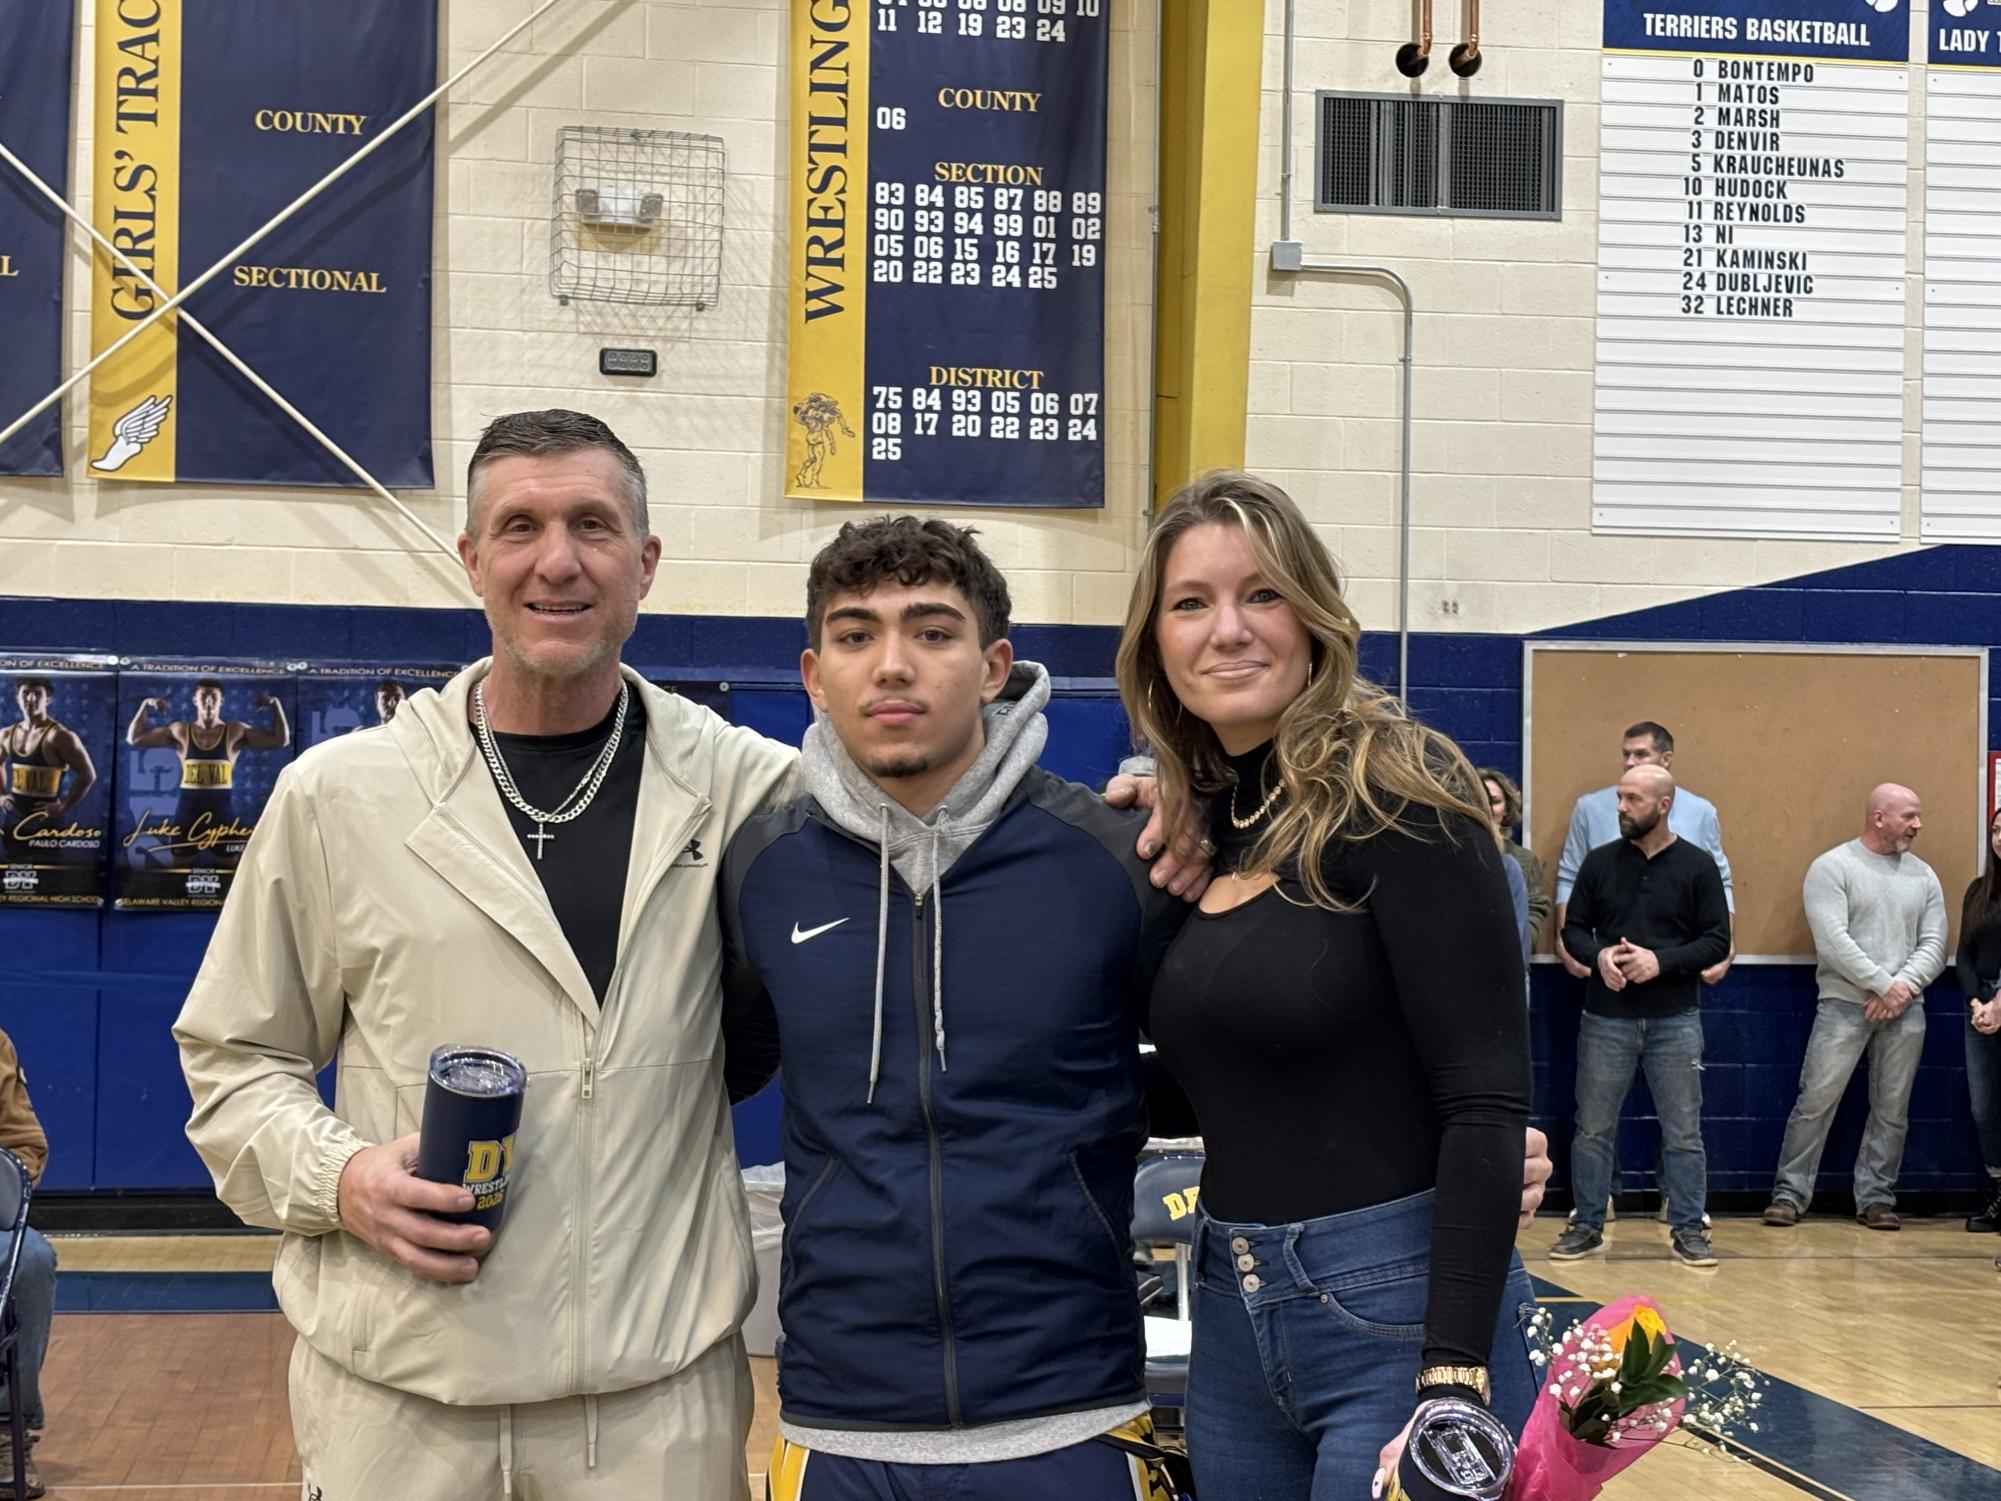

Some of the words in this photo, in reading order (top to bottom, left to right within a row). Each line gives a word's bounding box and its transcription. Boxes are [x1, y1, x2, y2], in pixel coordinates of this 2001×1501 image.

[1076, 0, 1099, 17] 10
[878, 9, 896, 31] 11
[918, 11, 942, 33] 12
[959, 13, 982, 36] 19
[997, 16, 1025, 38] 23
[1037, 19, 1065, 41] 24
[1644, 14, 1737, 39] TERRIERS
[1747, 18, 1870, 46] BASKETBALL
[1940, 29, 1989, 52] LADY
[1694, 59, 1703, 77] 0
[1719, 60, 1813, 82] BONTEMPO
[939, 88, 1040, 111] COUNTY
[1695, 83, 1703, 101] 1
[1719, 84, 1778, 104] MATOS
[256, 110, 366, 134] COUNTY
[877, 107, 905, 129] 06
[1693, 107, 1704, 126] 2
[1718, 107, 1779, 128] MARSH
[1692, 130, 1701, 148] 3
[1715, 131, 1779, 151] DENVIR
[805, 0, 851, 324] WRESTLING
[935, 162, 1043, 185] SECTION
[1692, 153, 1701, 172] 5
[1714, 154, 1843, 177] KRAUCHEUNAS
[876, 182, 904, 205] 83
[915, 184, 944, 207] 84
[955, 186, 983, 208] 85
[995, 188, 1023, 210] 87
[1034, 190, 1061, 212] 88
[1073, 192, 1100, 214] 89
[1684, 177, 1701, 195] 10
[1716, 178, 1786, 199] HUDOCK
[875, 208, 903, 230] 90
[915, 210, 943, 232] 93
[955, 212, 983, 234] 94
[994, 214, 1022, 236] 99
[1034, 216, 1055, 238] 01
[1072, 218, 1100, 239] 02
[1688, 201, 1701, 219] 11
[1714, 202, 1804, 223] REYNOLDS
[1684, 224, 1702, 243] 13
[1717, 225, 1732, 244] NI
[875, 234, 903, 256] 05
[915, 236, 943, 258] 06
[955, 239, 978, 260] 15
[996, 241, 1019, 263] 16
[1033, 242, 1056, 264] 17
[1072, 245, 1095, 266] 19
[1684, 248, 1701, 267] 21
[1717, 249, 1806, 270] KAMINSKI
[234, 266, 386, 292] SECTIONAL
[874, 260, 902, 282] 20
[914, 261, 942, 283] 22
[951, 263, 980, 285] 23
[992, 265, 1021, 287] 24
[1029, 267, 1057, 288] 25
[1683, 272, 1706, 291] 24
[1717, 273, 1813, 294] DUBLJEVIC
[1682, 295, 1703, 314] 32
[1717, 296, 1792, 317] LECHNER
[930, 367, 1044, 389] DISTRICT
[873, 387, 902, 409] 75
[913, 388, 941, 410] 84
[953, 390, 980, 411] 93
[992, 391, 1020, 413] 05
[1031, 393, 1058, 414] 06
[1070, 393, 1098, 415] 07
[873, 413, 901, 434] 08
[915, 413, 938, 435] 17
[953, 415, 980, 436] 20
[991, 416, 1019, 438] 22
[1030, 418, 1058, 440] 23
[1068, 419, 1096, 440] 24
[873, 438, 901, 460] 25
[143, 664, 199, 673] TRADITION
[201, 665, 216, 673] OF
[218, 667, 285, 676] EXCELLENCE
[320, 667, 375, 676] TRADITION
[377, 668, 392, 676] OF
[13, 811, 102, 840] Cardoso
[123, 809, 181, 848] Luke
[59, 840, 101, 849] CARDOSO
